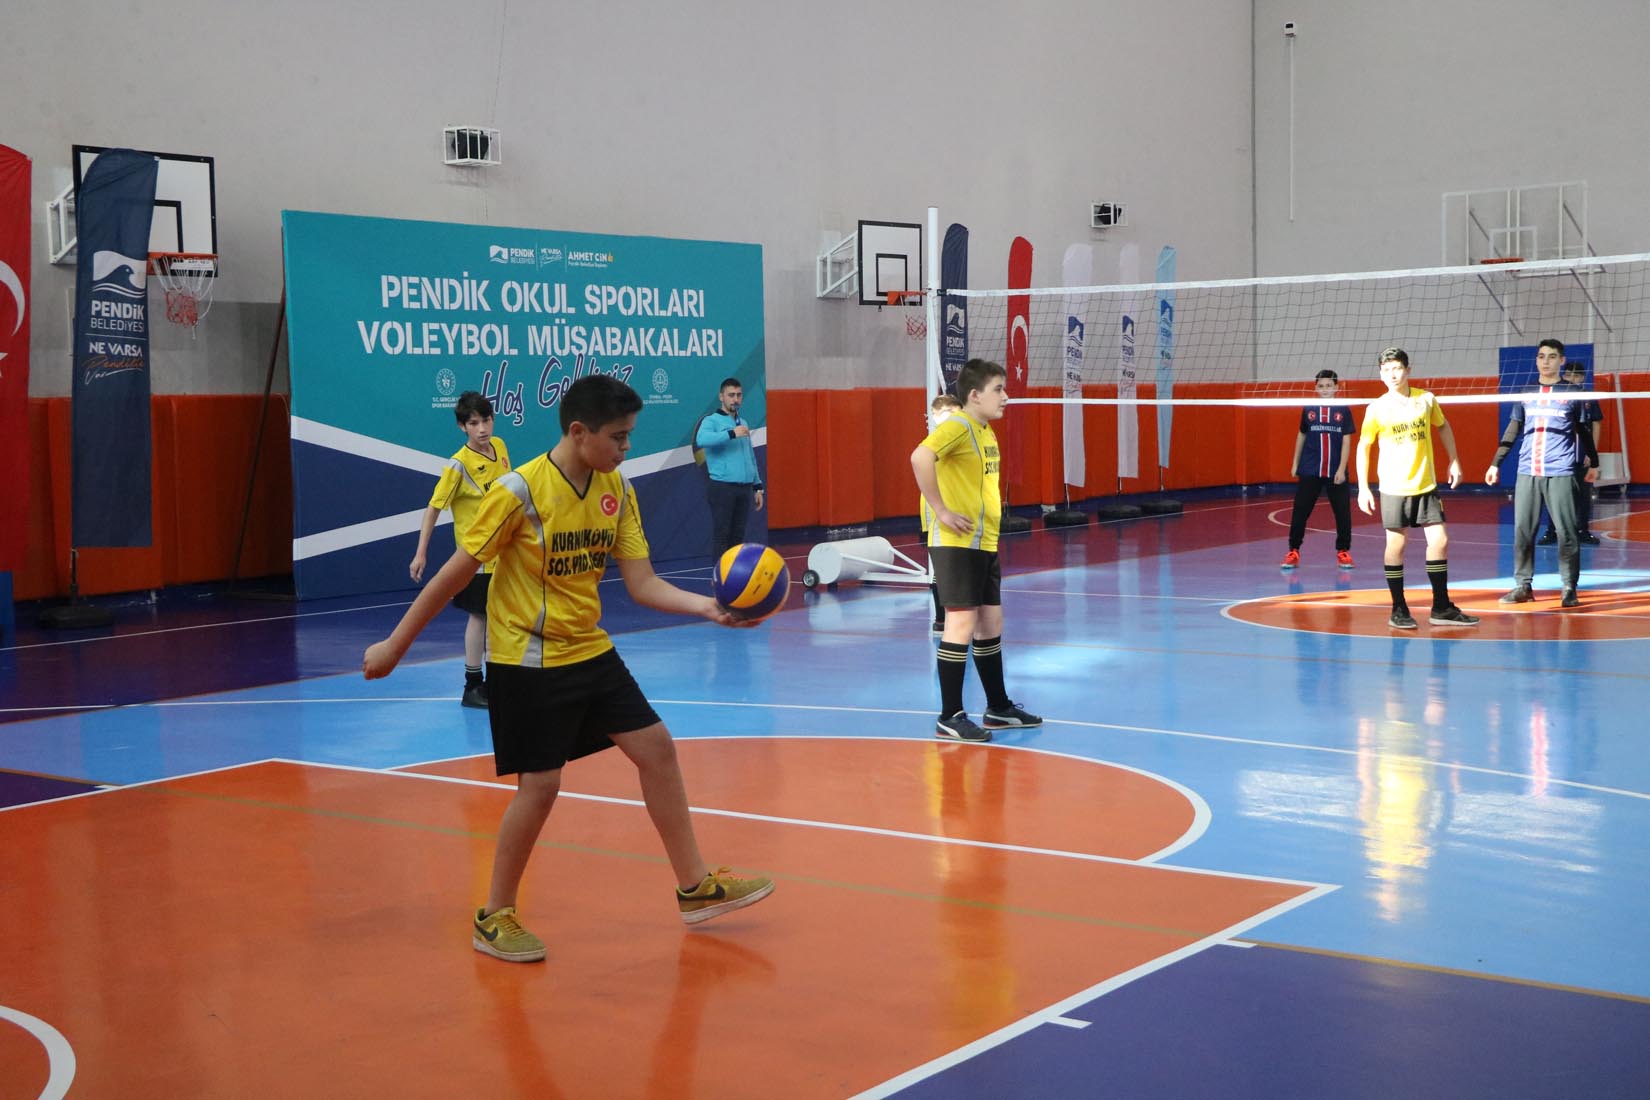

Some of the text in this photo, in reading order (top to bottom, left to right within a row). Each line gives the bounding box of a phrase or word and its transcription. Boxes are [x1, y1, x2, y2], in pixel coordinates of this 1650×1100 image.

[568, 251, 593, 262] AHMET
[381, 271, 705, 318] PENDİK OKUL SPORLARI
[89, 342, 143, 357] NE VARSA
[357, 318, 724, 357] VOLEYBOL MÜSABAKALARI
[481, 359, 525, 426] Hoş
